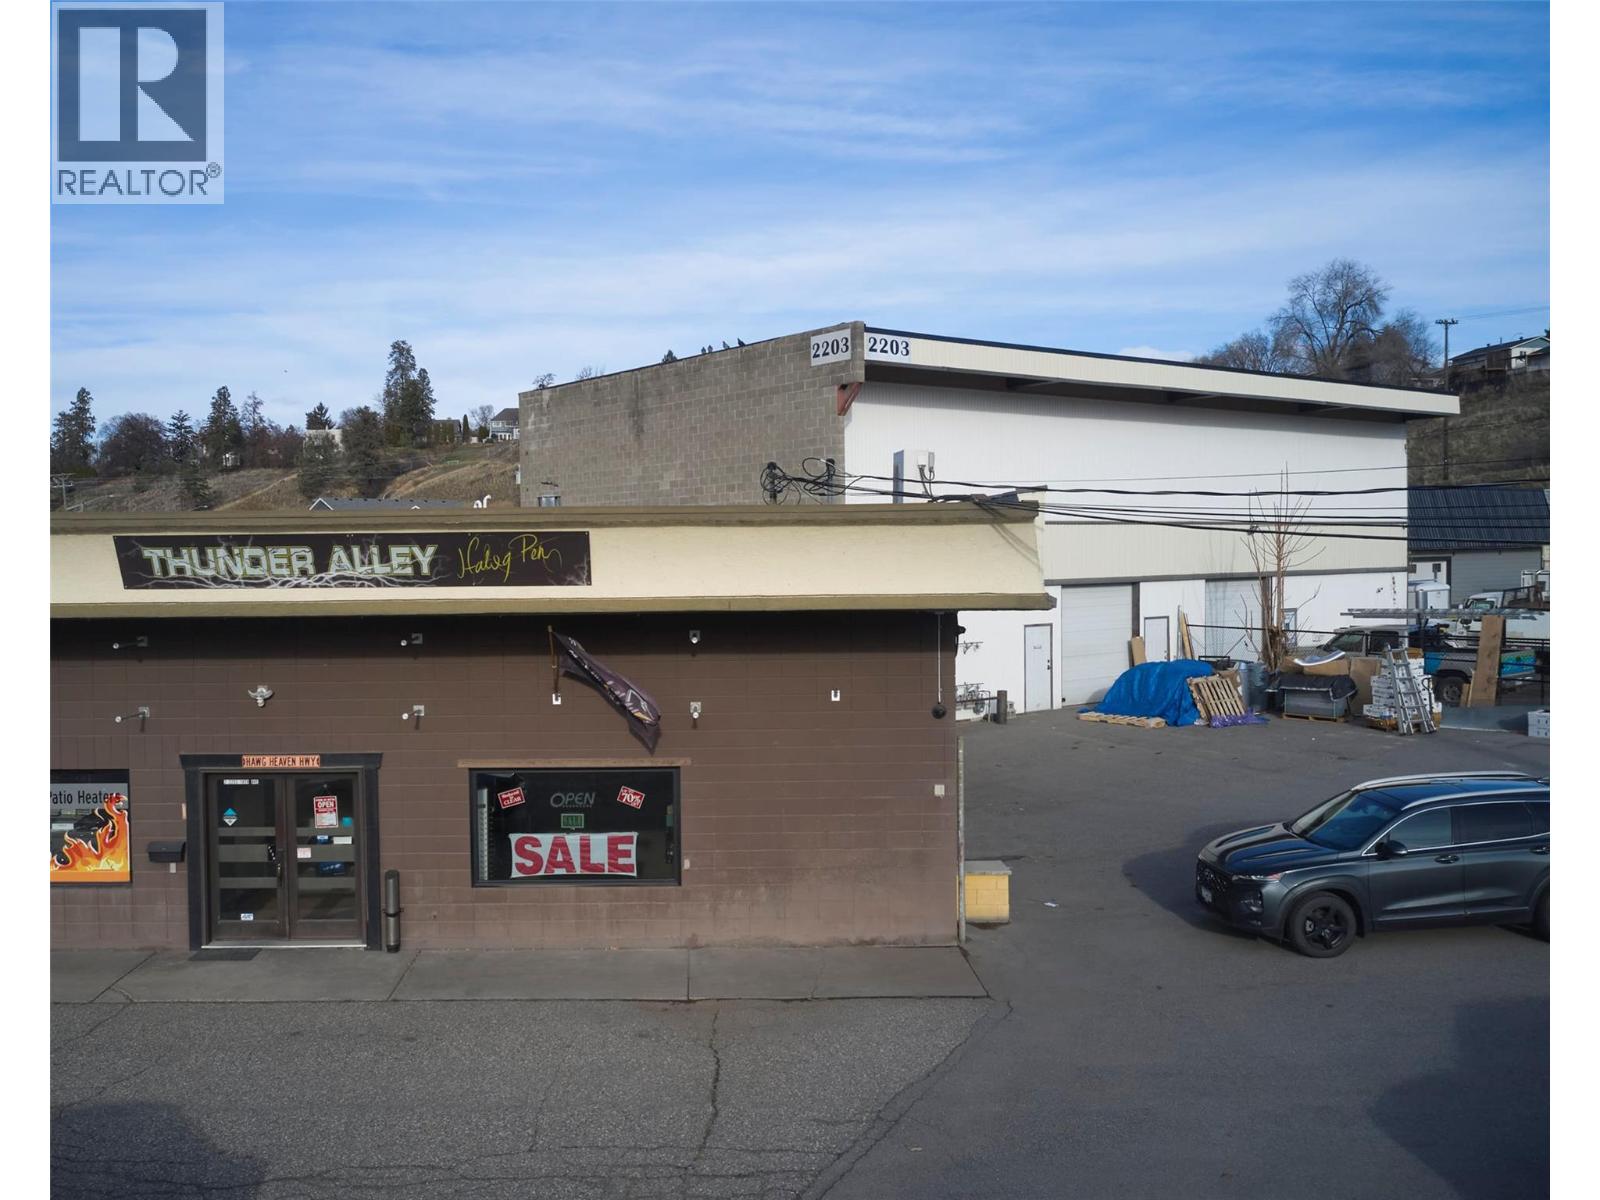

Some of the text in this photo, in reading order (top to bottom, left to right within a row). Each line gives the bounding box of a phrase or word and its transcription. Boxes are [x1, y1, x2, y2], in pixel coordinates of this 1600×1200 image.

[812, 336, 850, 359] 2203
[868, 336, 910, 357] 2203
[142, 544, 439, 577] THUNDER ALLEY
[269, 756, 297, 767] HEAVEN
[317, 800, 335, 809] OPEN
[550, 791, 596, 808] OPEN
[514, 835, 636, 876] SALE
